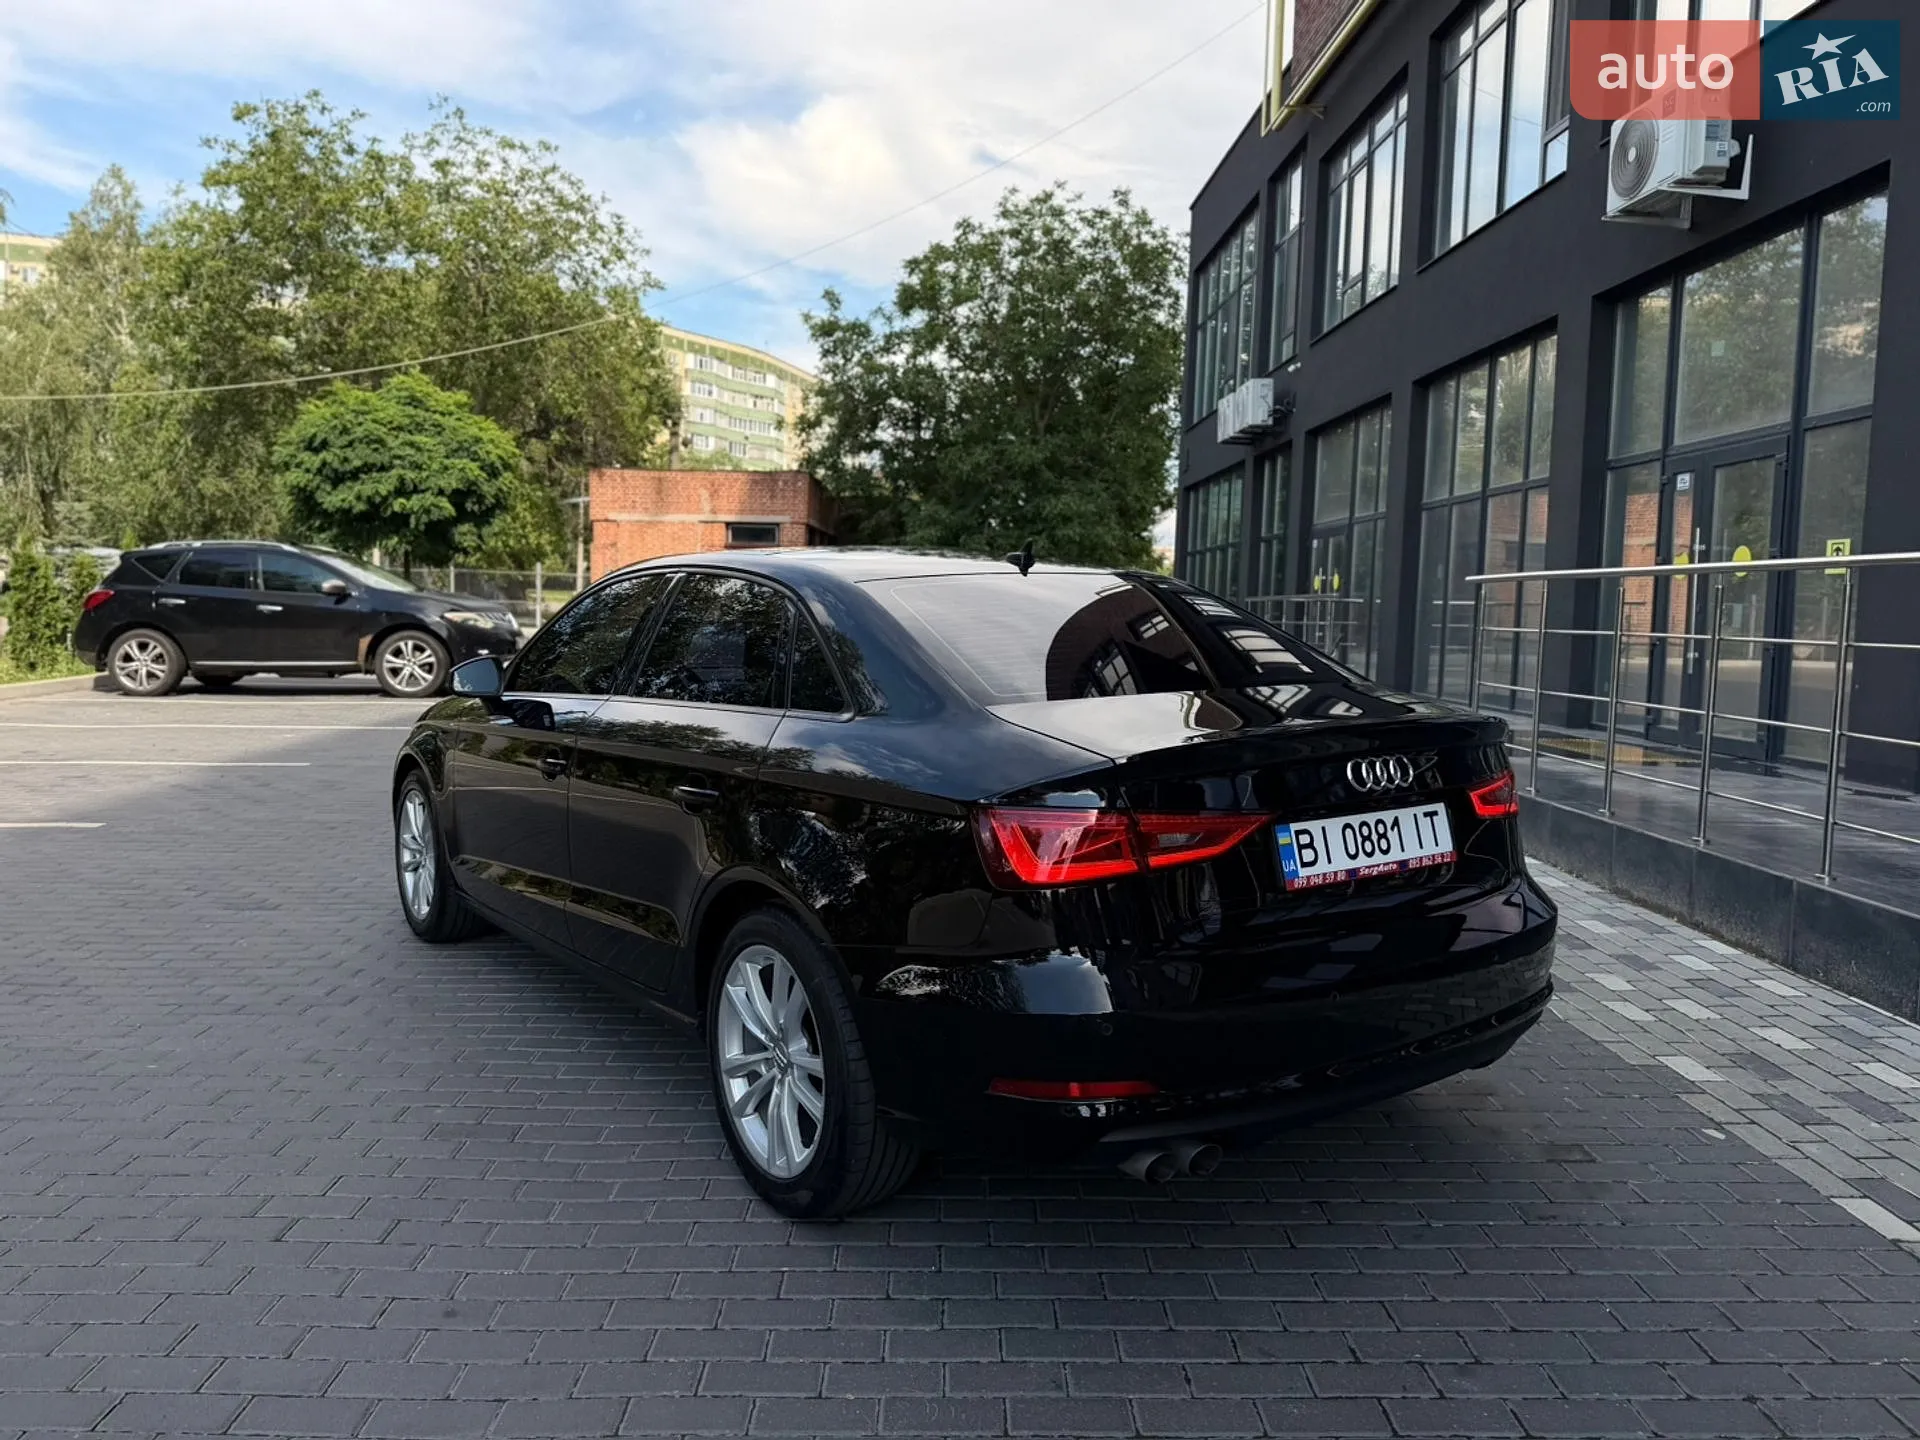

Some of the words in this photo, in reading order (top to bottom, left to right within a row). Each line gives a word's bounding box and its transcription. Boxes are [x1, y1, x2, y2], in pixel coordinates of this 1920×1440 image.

[1294, 828, 1332, 868] BI
[1341, 816, 1405, 860] 0881
[1414, 810, 1439, 849] IT
[1282, 859, 1296, 872] UA
